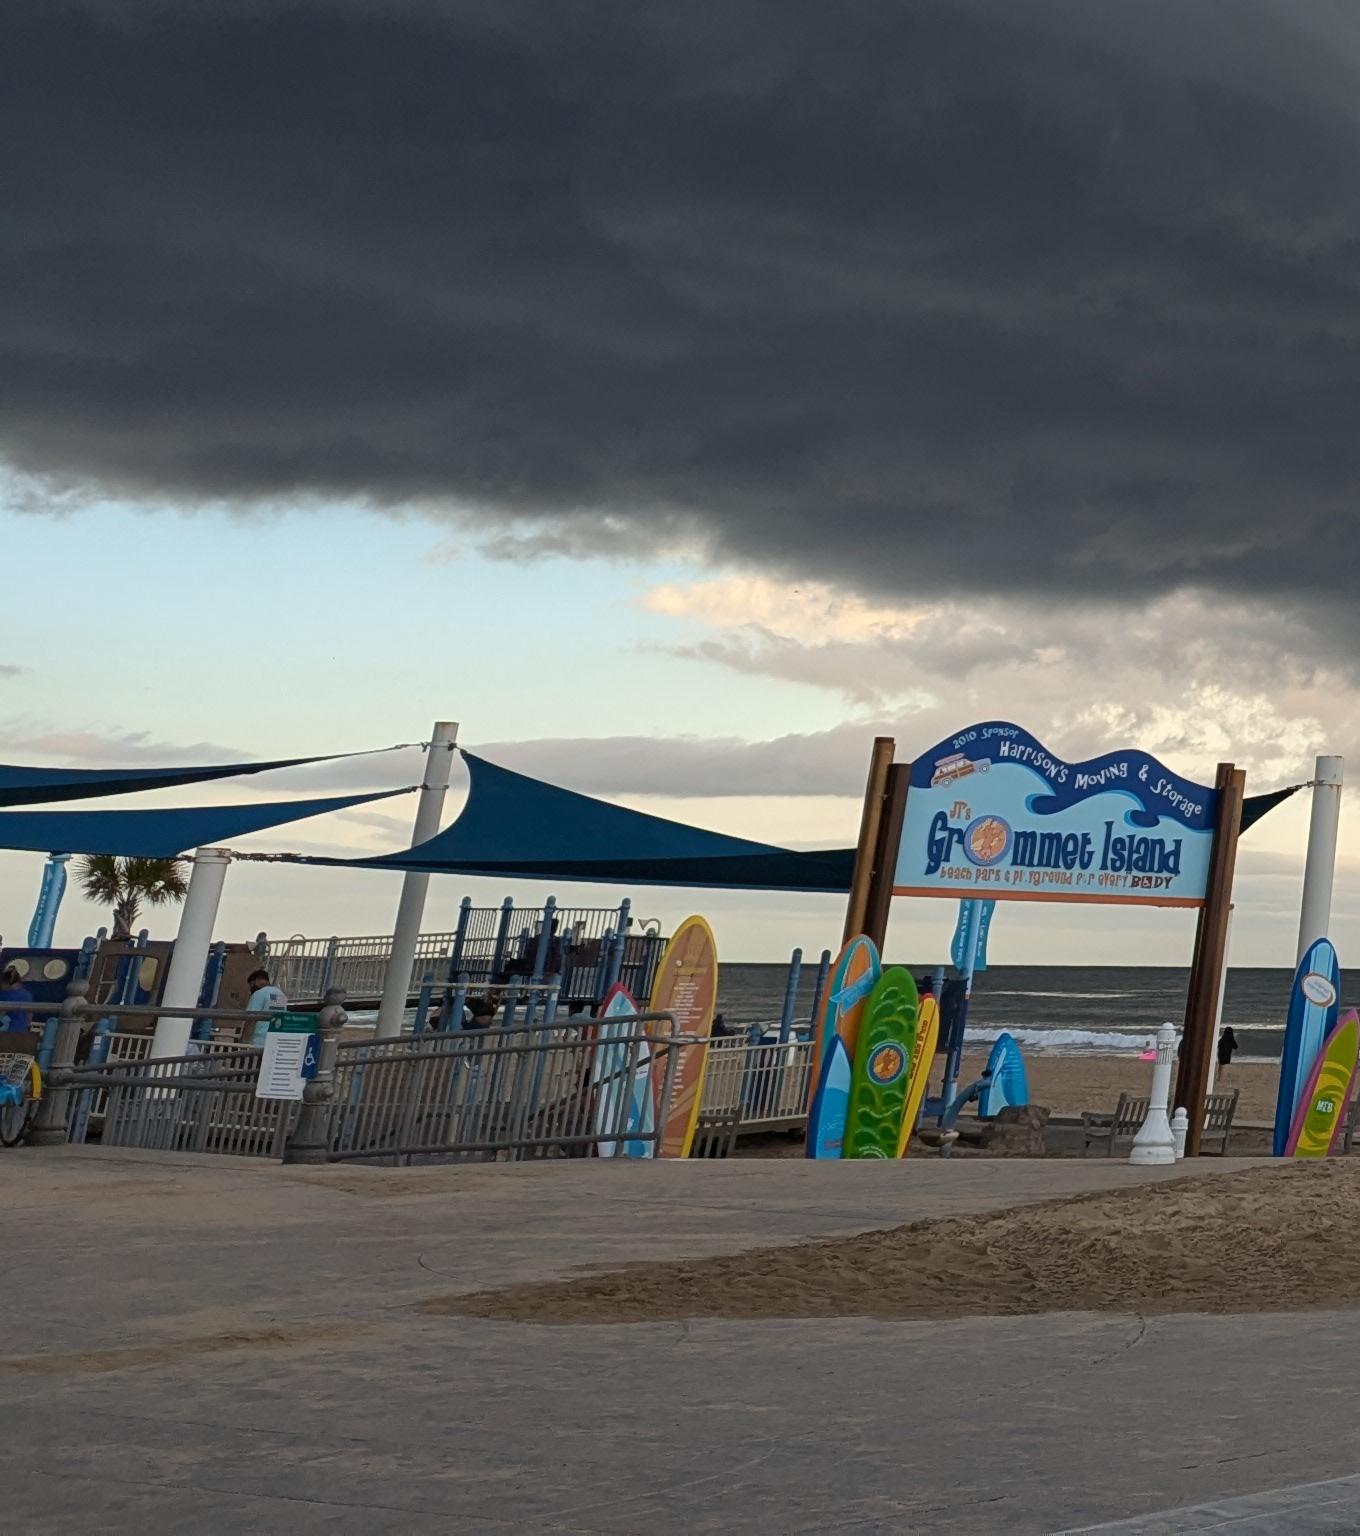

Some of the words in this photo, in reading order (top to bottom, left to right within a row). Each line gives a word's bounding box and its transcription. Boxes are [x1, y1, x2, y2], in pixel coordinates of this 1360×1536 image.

[953, 731, 977, 749] 2010
[980, 727, 1020, 739] Sponsor
[1000, 741, 1069, 783] Harrison's
[1074, 763, 1128, 790] Moving
[1139, 764, 1149, 782] &
[1150, 779, 1202, 817] Storage
[1099, 820, 1183, 875] Island
[974, 867, 1001, 883] park
[1012, 869, 1072, 886] plyground
